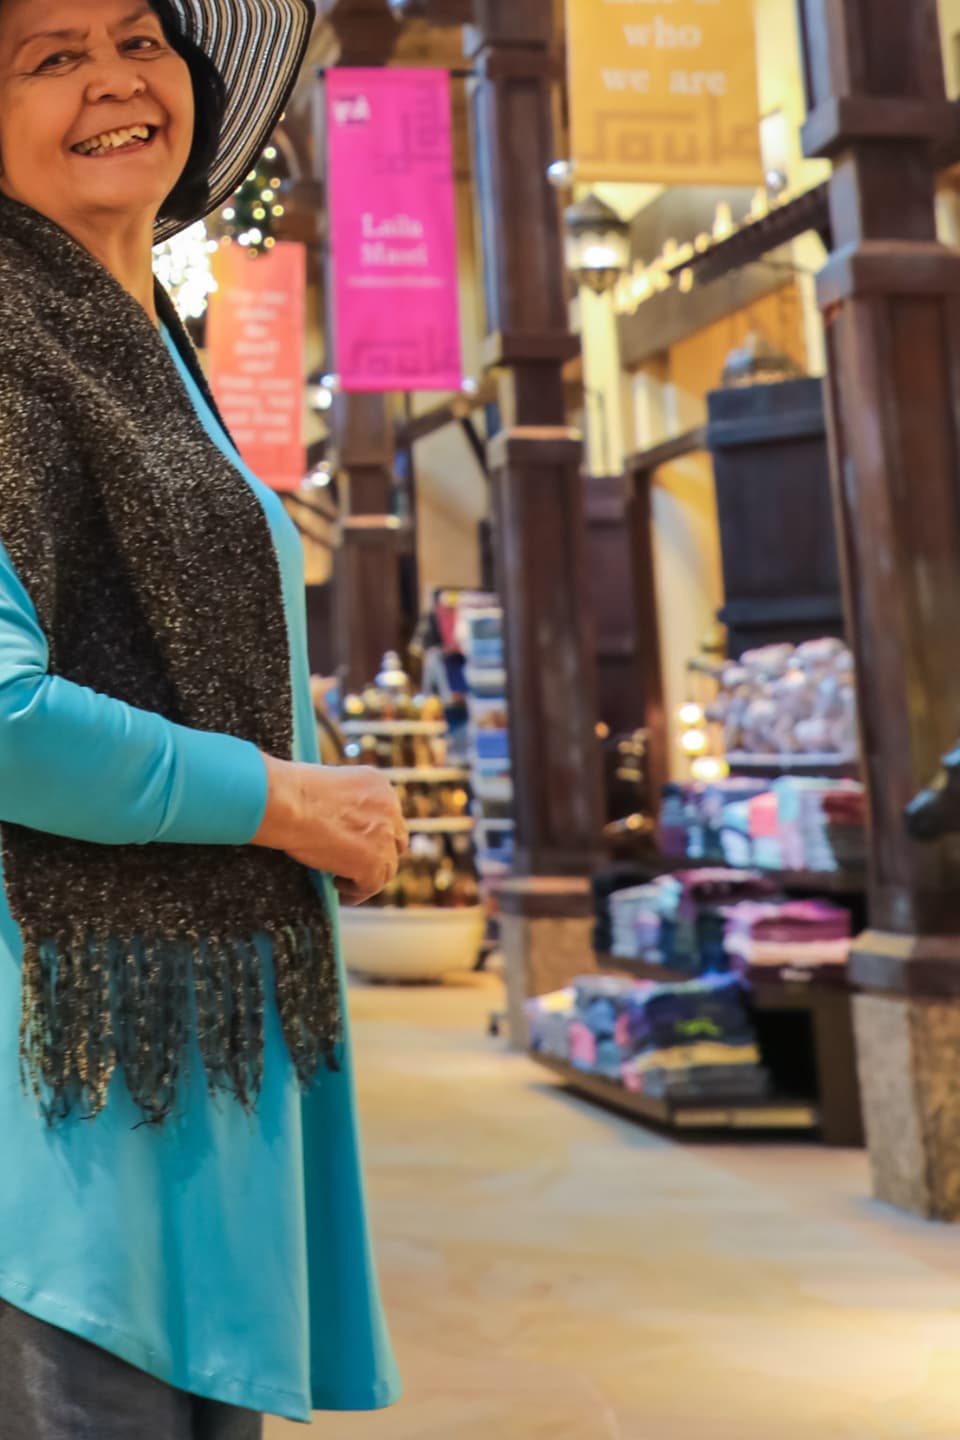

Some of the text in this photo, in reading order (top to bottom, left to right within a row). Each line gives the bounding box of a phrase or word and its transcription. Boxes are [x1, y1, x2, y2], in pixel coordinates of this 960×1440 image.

[622, 15, 704, 50] who
[600, 66, 728, 96] we are
